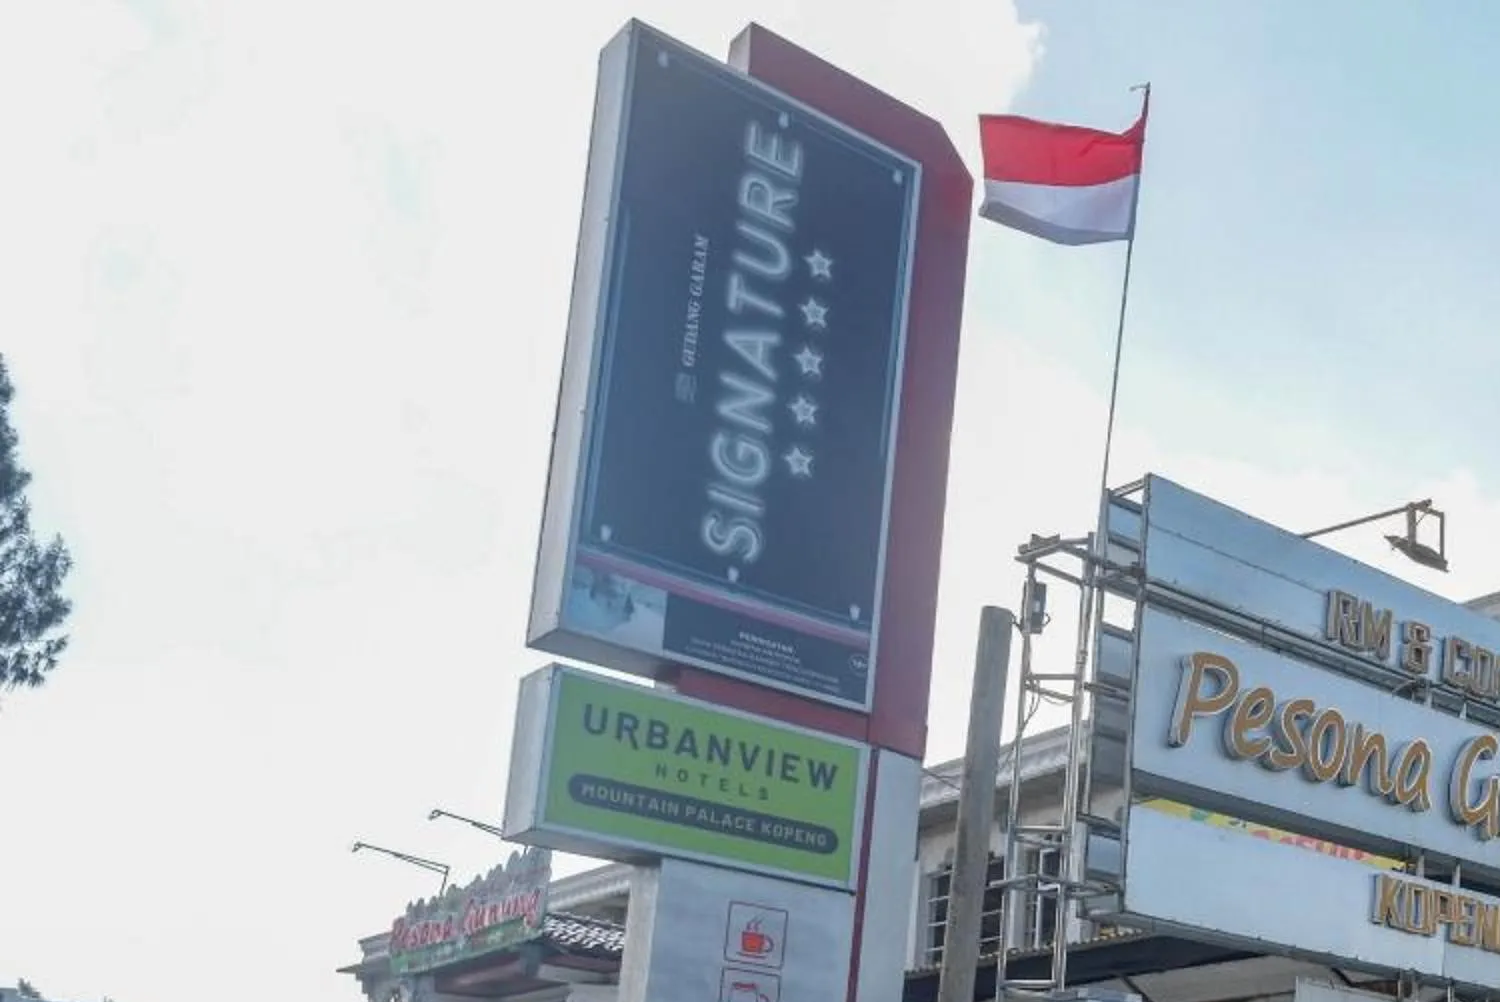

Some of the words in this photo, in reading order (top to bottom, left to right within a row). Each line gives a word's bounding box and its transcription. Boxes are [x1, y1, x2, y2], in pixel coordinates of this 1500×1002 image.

[681, 299, 701, 368] GUDANG
[703, 121, 804, 564] SIGNATURE
[1326, 590, 1392, 660] RM
[583, 704, 838, 791] URBANVIEW
[1167, 651, 1433, 813] Pesona
[581, 783, 679, 817] MOUNTAIN
[684, 806, 754, 832] PALACE
[760, 820, 827, 847] KOPENG
[655, 763, 770, 801] HOTELS
